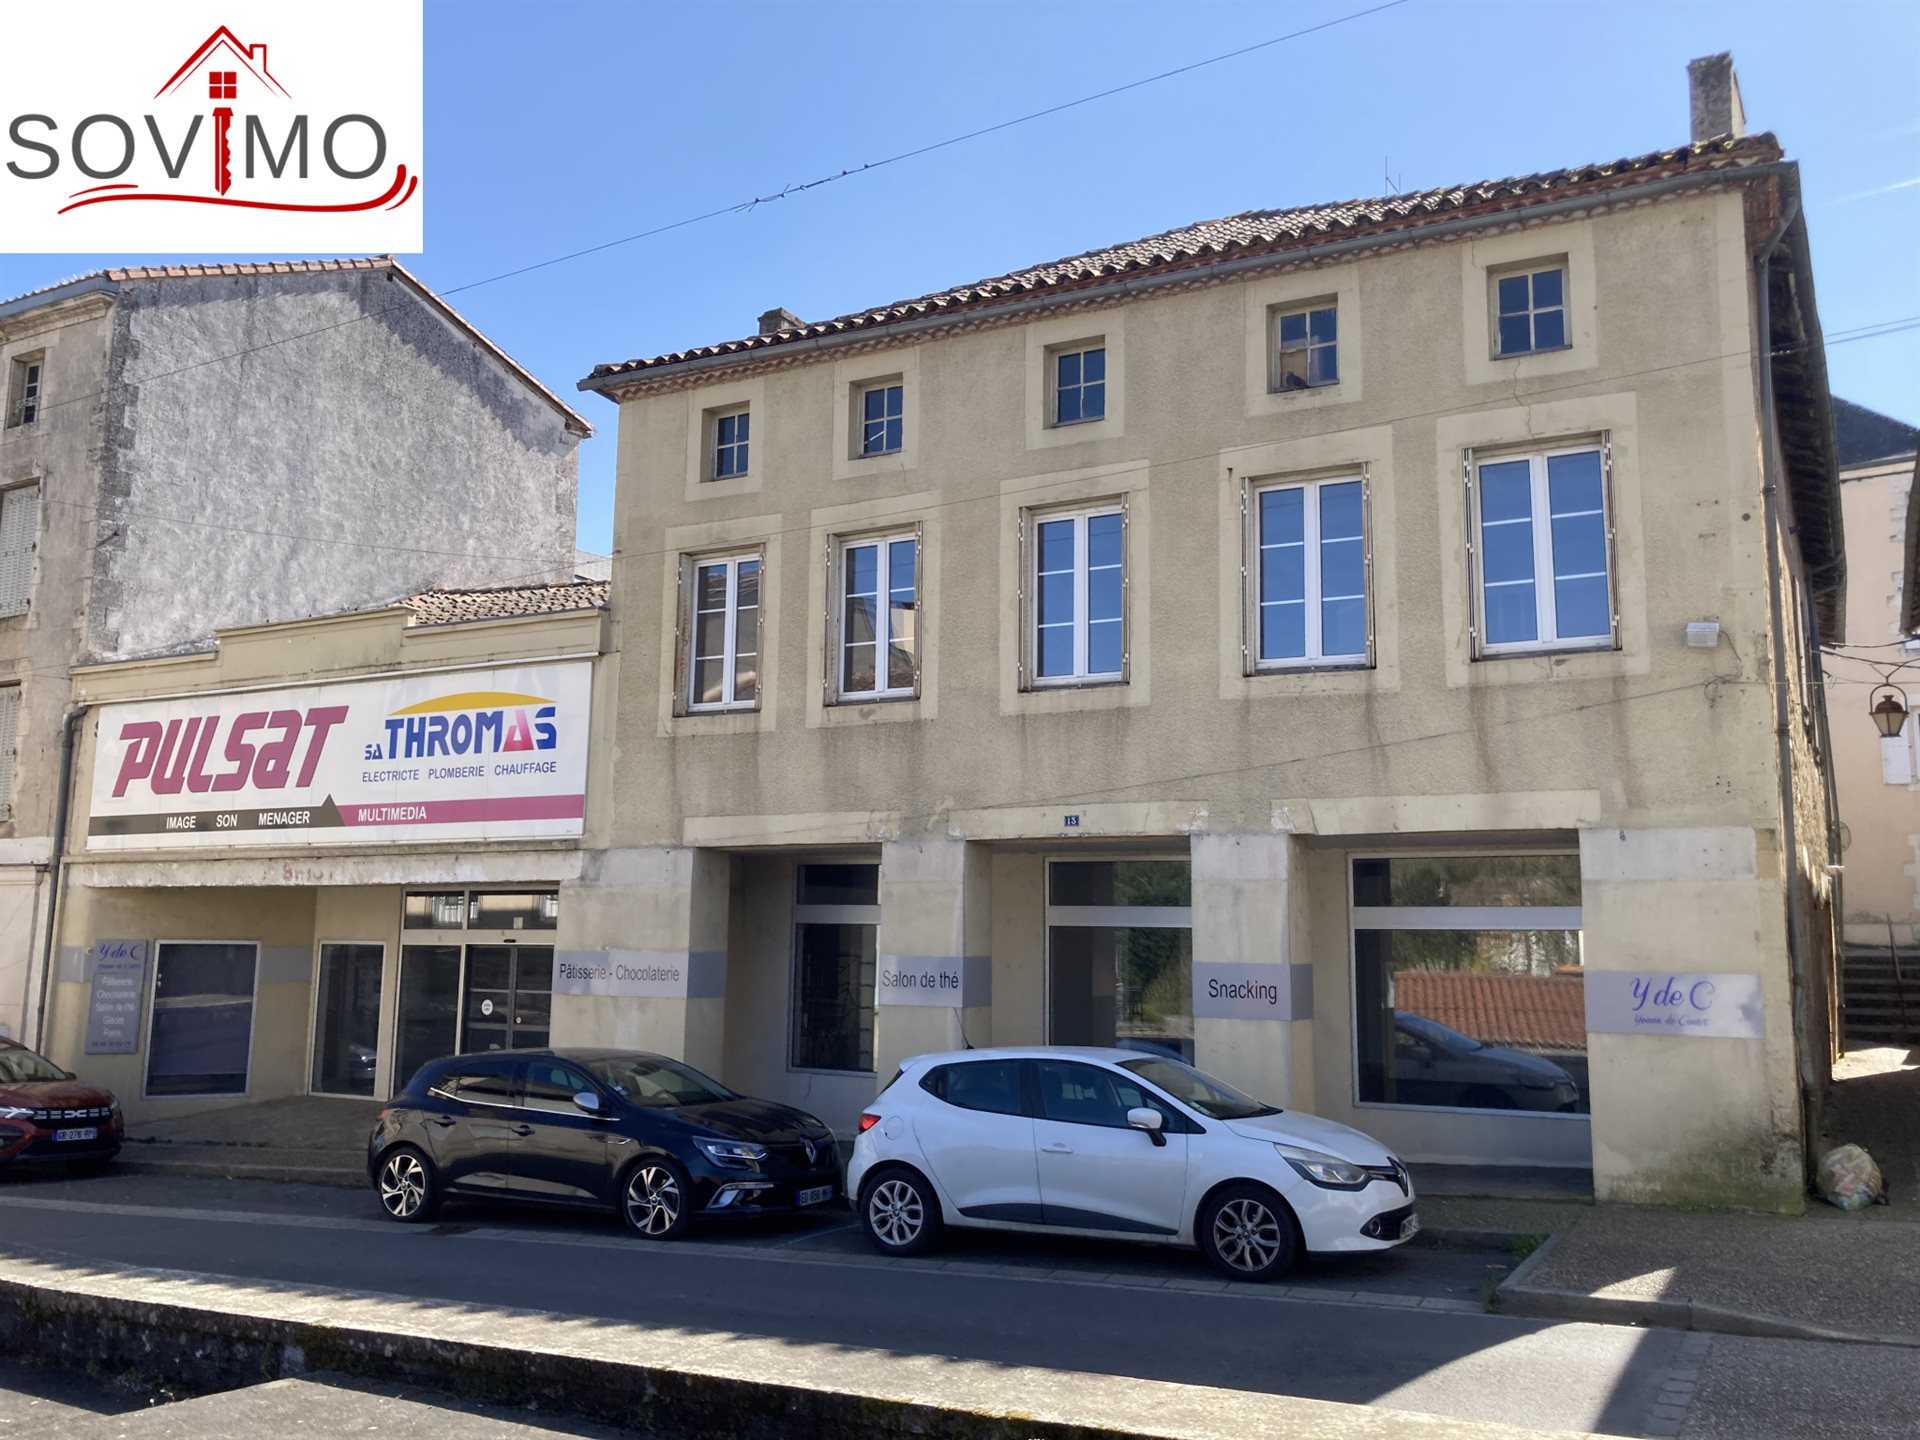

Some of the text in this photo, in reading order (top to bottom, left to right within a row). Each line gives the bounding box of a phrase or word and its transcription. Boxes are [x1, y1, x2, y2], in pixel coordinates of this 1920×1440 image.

[364, 706, 557, 760] SA THROMAS
[428, 765, 485, 779] PLOMBERIE
[494, 761, 557, 777] CHAUFFAGE
[166, 811, 310, 829] IMAGE SON MENAGER
[358, 806, 427, 822] MULTIMEDIA
[559, 963, 607, 980] Pâtisserie
[615, 964, 680, 982] Chocolaterie
[882, 970, 959, 989] Salon de thé
[1208, 978, 1277, 1005] Snacking
[1653, 976, 1684, 1006] de
[1689, 981, 1716, 1011] C
